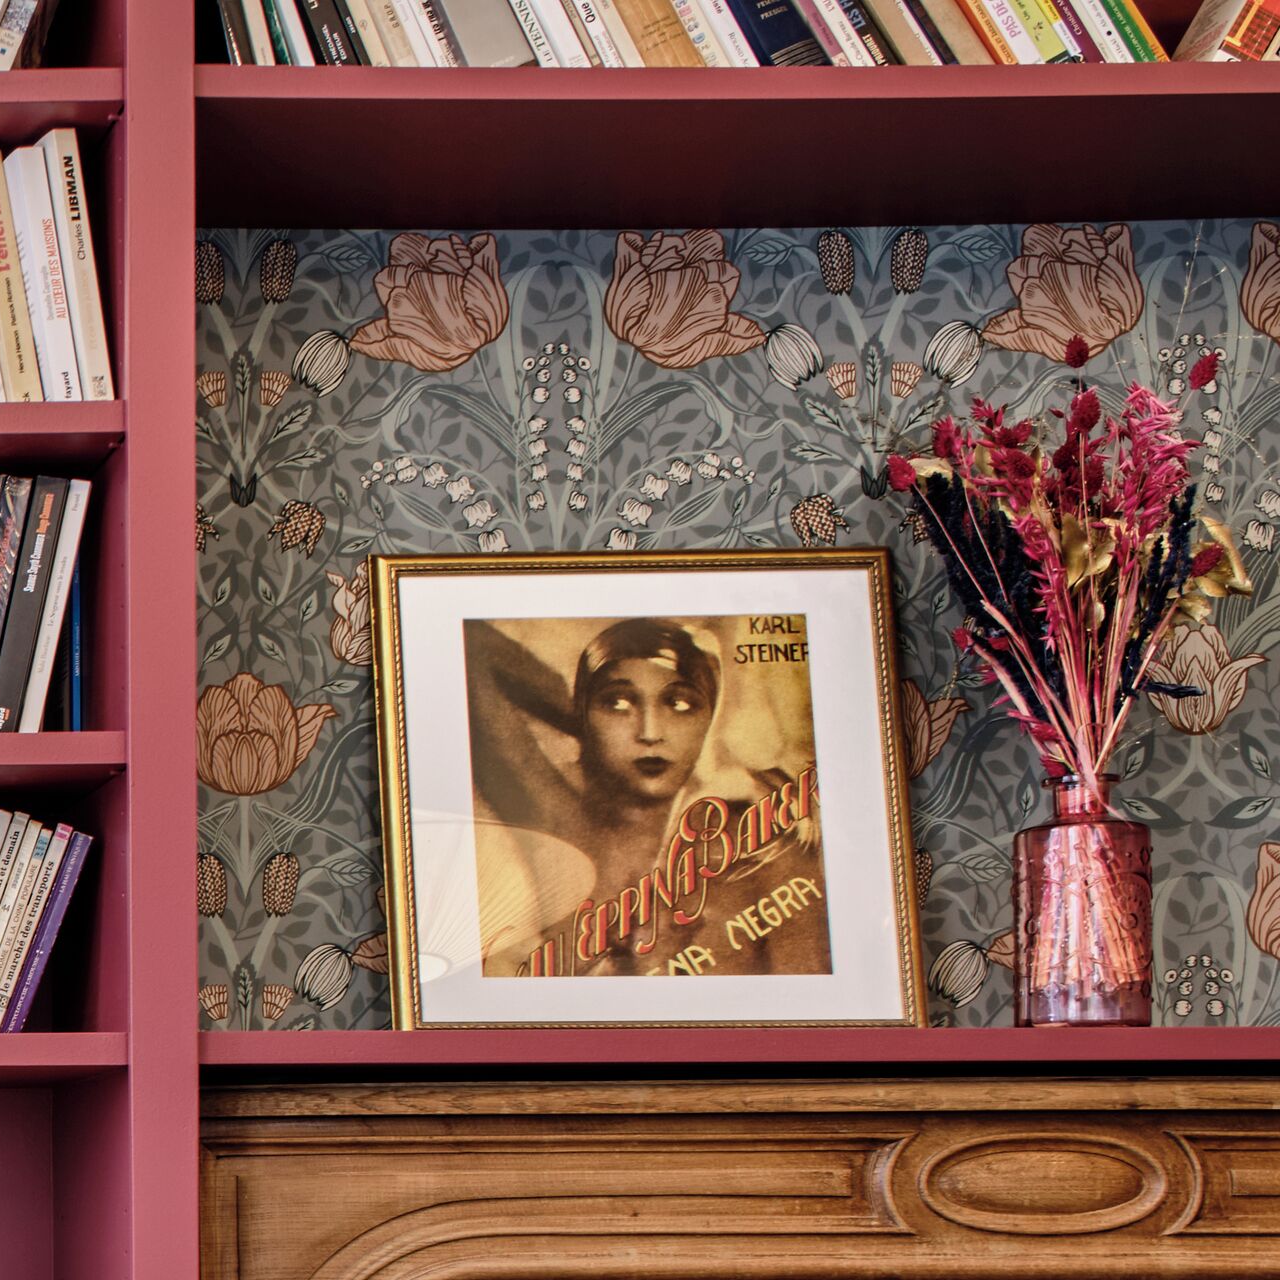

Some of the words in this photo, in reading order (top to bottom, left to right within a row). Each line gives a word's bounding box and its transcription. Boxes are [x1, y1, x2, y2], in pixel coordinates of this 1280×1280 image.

[63, 155, 81, 221] LIBMAN
[75, 223, 86, 260] Charles
[61, 371, 73, 399] fayard
[748, 615, 801, 635] KARL
[1, 831, 20, 866] demain
[0, 867, 7, 877] et
[0, 982, 10, 993] le
[6, 940, 25, 981] marché
[20, 919, 33, 938] des
[28, 861, 54, 917] transports
